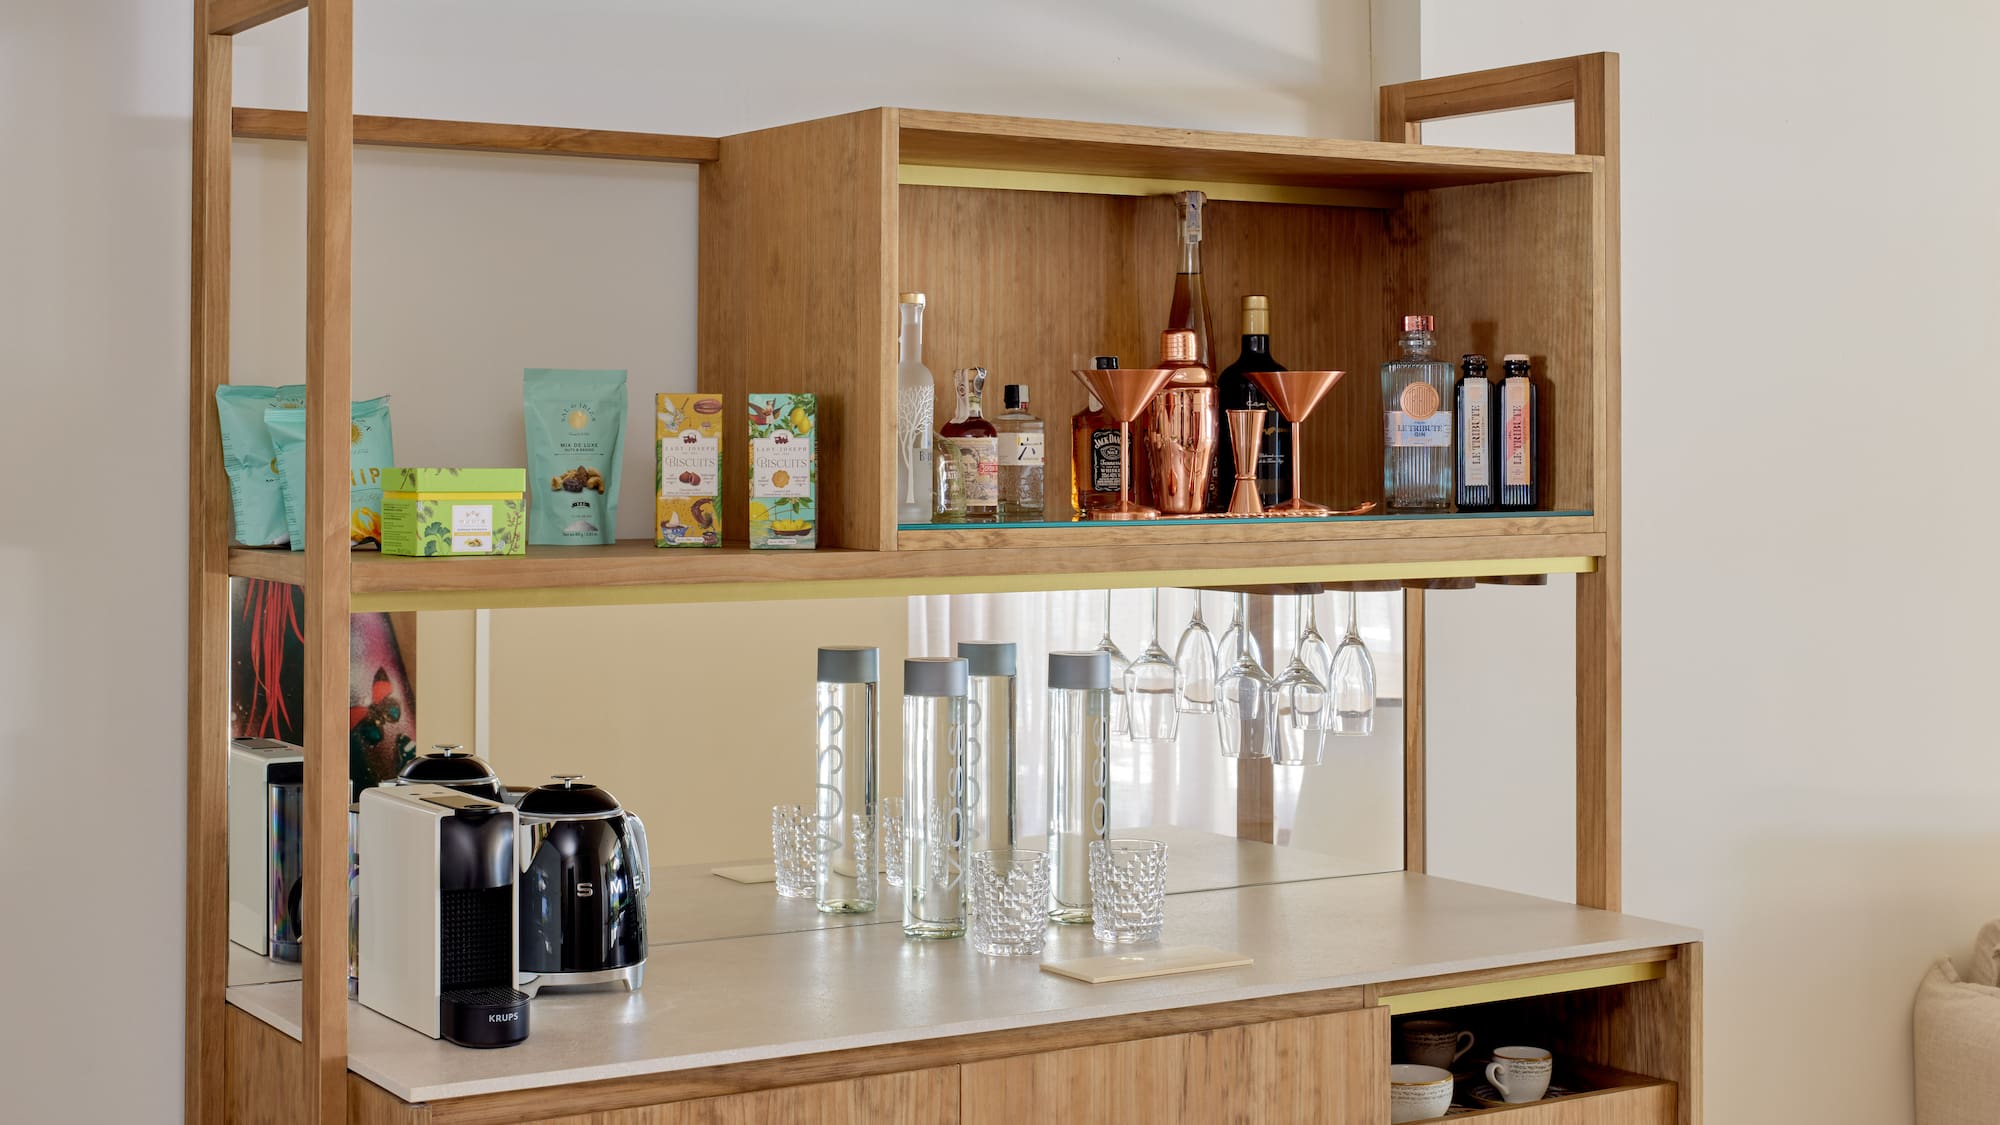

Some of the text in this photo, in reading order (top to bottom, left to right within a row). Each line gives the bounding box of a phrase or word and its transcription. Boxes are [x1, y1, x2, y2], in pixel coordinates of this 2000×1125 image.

[664, 455, 716, 468] BISCUITS
[756, 456, 808, 469] BISCUITS
[576, 873, 646, 898] SME
[488, 1011, 519, 1023] KRUPS
